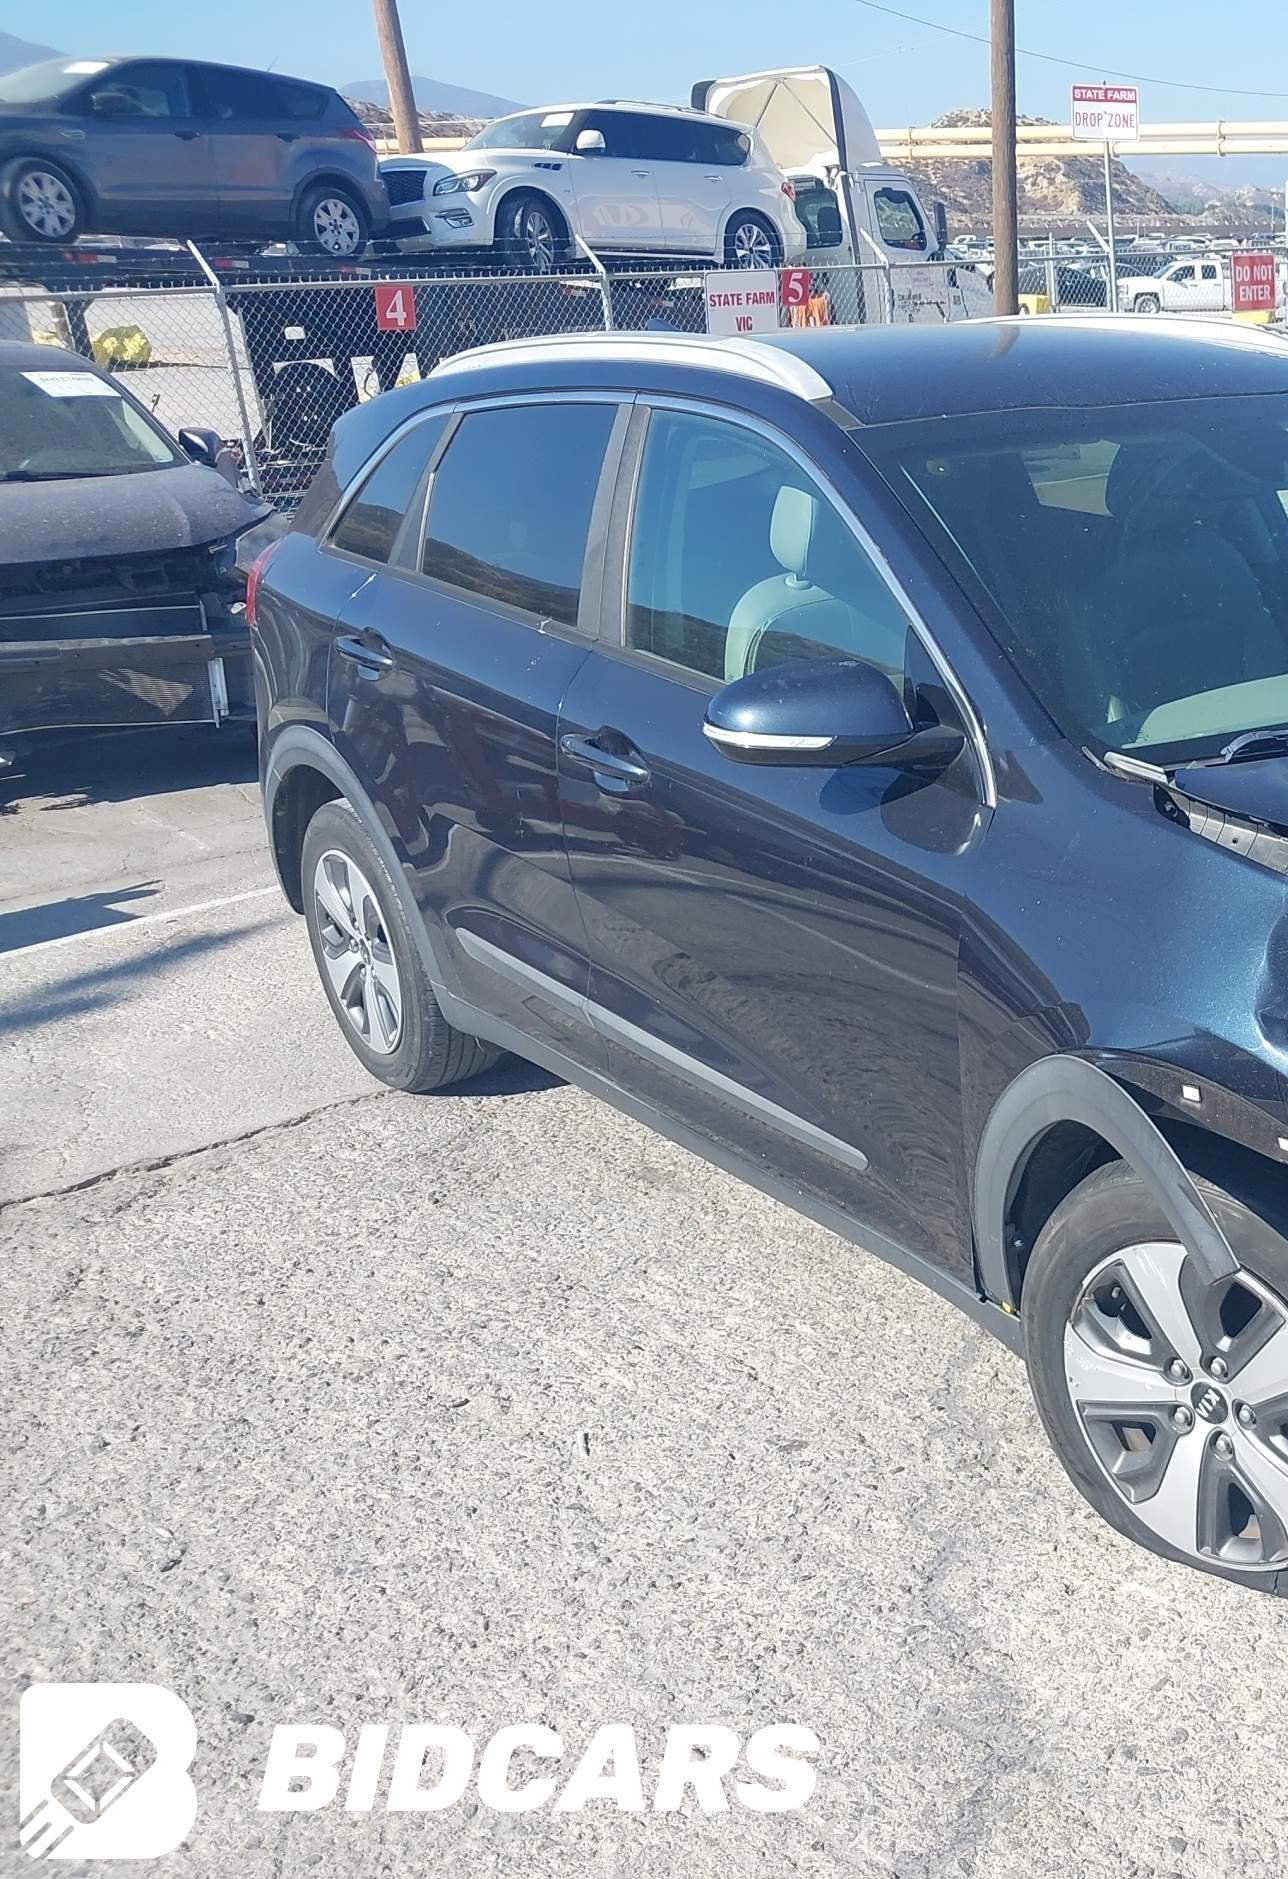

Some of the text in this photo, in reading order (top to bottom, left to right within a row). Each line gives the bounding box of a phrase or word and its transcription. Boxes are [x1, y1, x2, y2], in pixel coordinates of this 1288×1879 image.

[1074, 88, 1136, 101] STATE FARM
[1075, 111, 1135, 128] DROP ZONE
[1235, 264, 1273, 282] DO NOT
[787, 272, 804, 303] 5
[1239, 284, 1271, 302] ENTER
[385, 289, 408, 326] 4
[709, 291, 775, 308] STATE FARM
[735, 315, 753, 332] VIC
[1195, 1387, 1221, 1418] KIA
